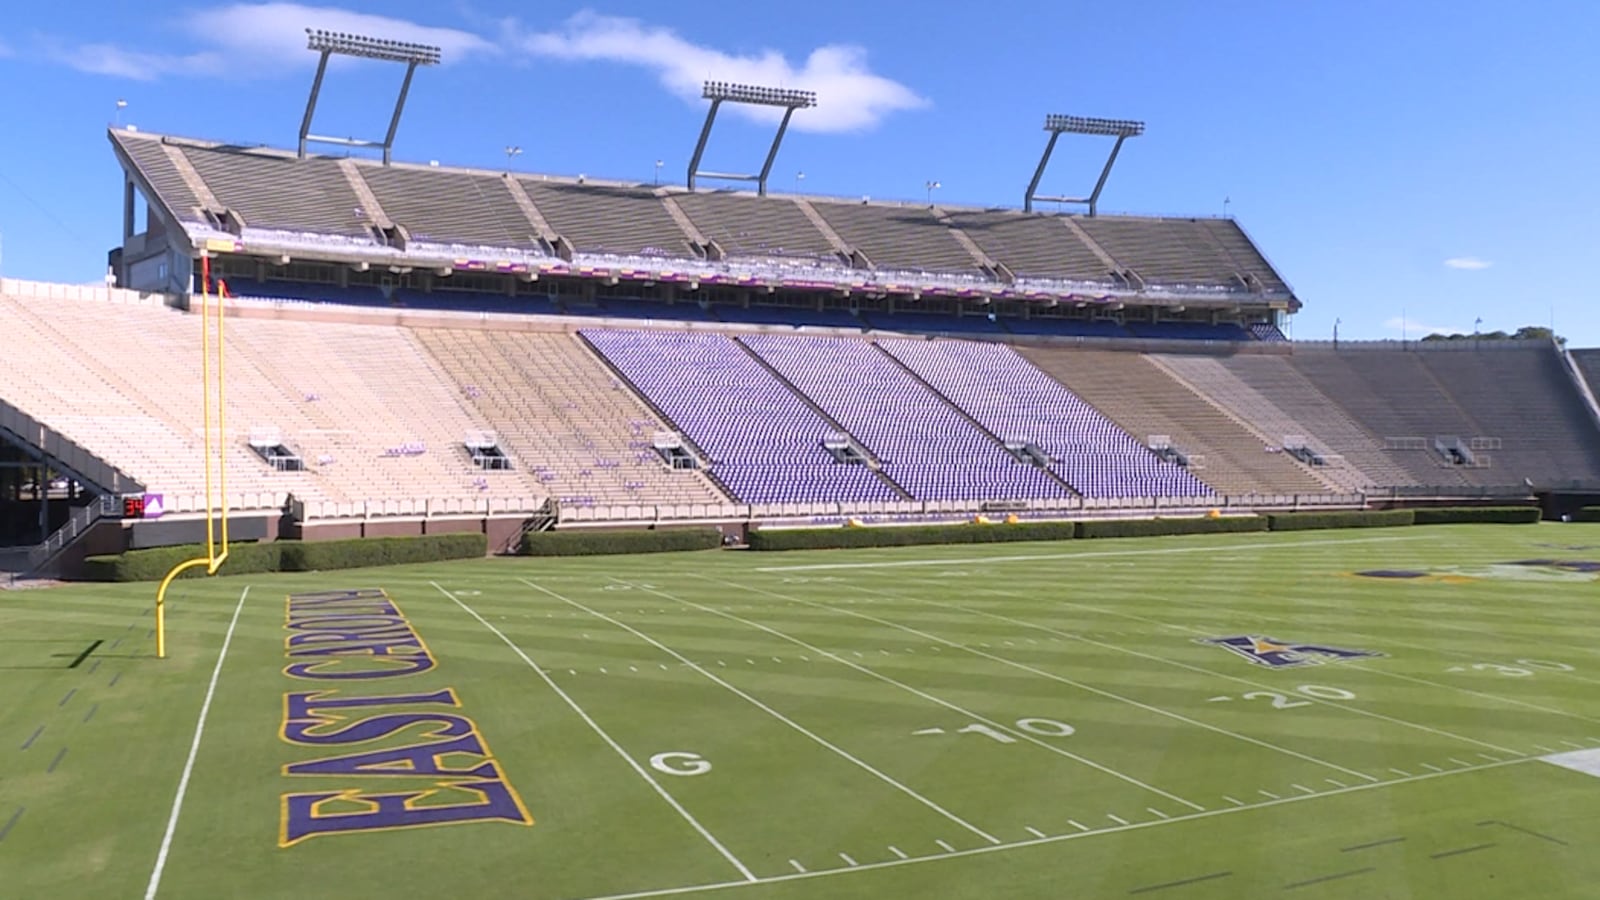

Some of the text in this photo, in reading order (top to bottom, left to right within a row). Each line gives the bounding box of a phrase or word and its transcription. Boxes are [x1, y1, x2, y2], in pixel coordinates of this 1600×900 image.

[1242, 684, 1356, 709] 20
[956, 717, 1076, 744] 10
[277, 687, 535, 848] EAST
[649, 751, 712, 776] G
